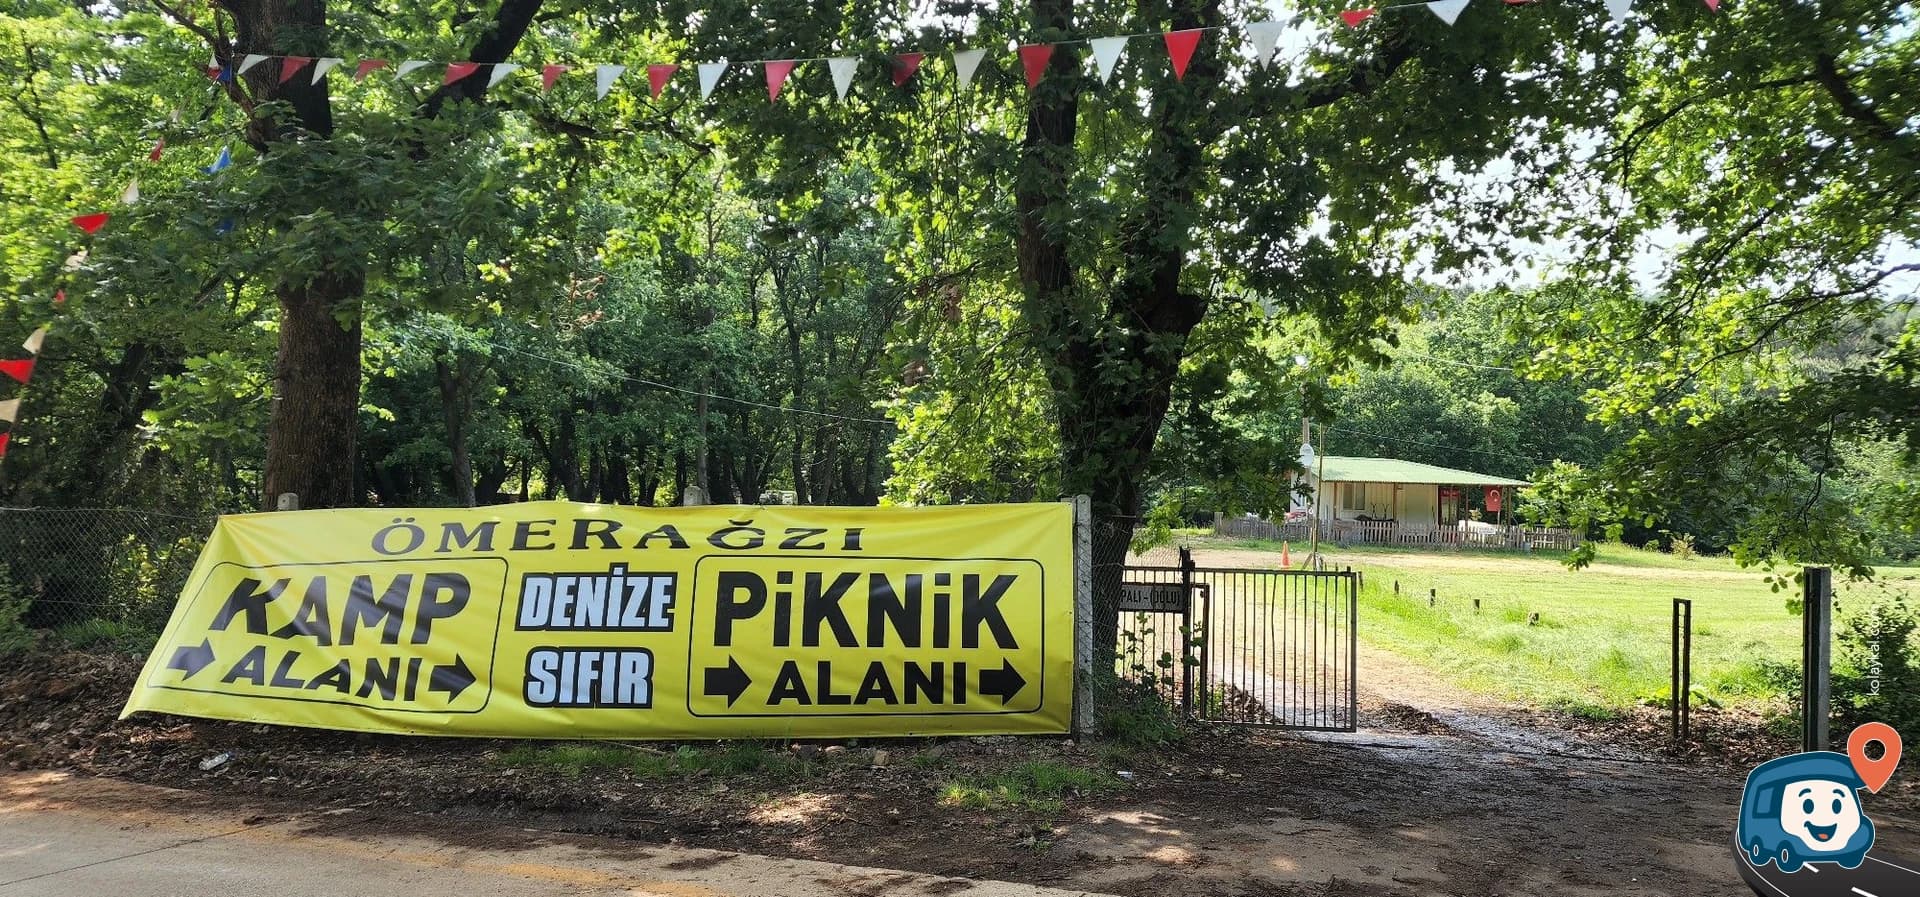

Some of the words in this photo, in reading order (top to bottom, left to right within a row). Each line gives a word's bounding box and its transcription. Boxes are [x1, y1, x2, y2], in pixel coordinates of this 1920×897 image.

[371, 517, 865, 556] ÖMERAĞZI
[208, 572, 472, 647] KAMP
[517, 564, 675, 630] DENİZE
[220, 644, 423, 702] ALANI
[526, 648, 653, 707] SIFIR
[766, 660, 968, 706] ALANI
